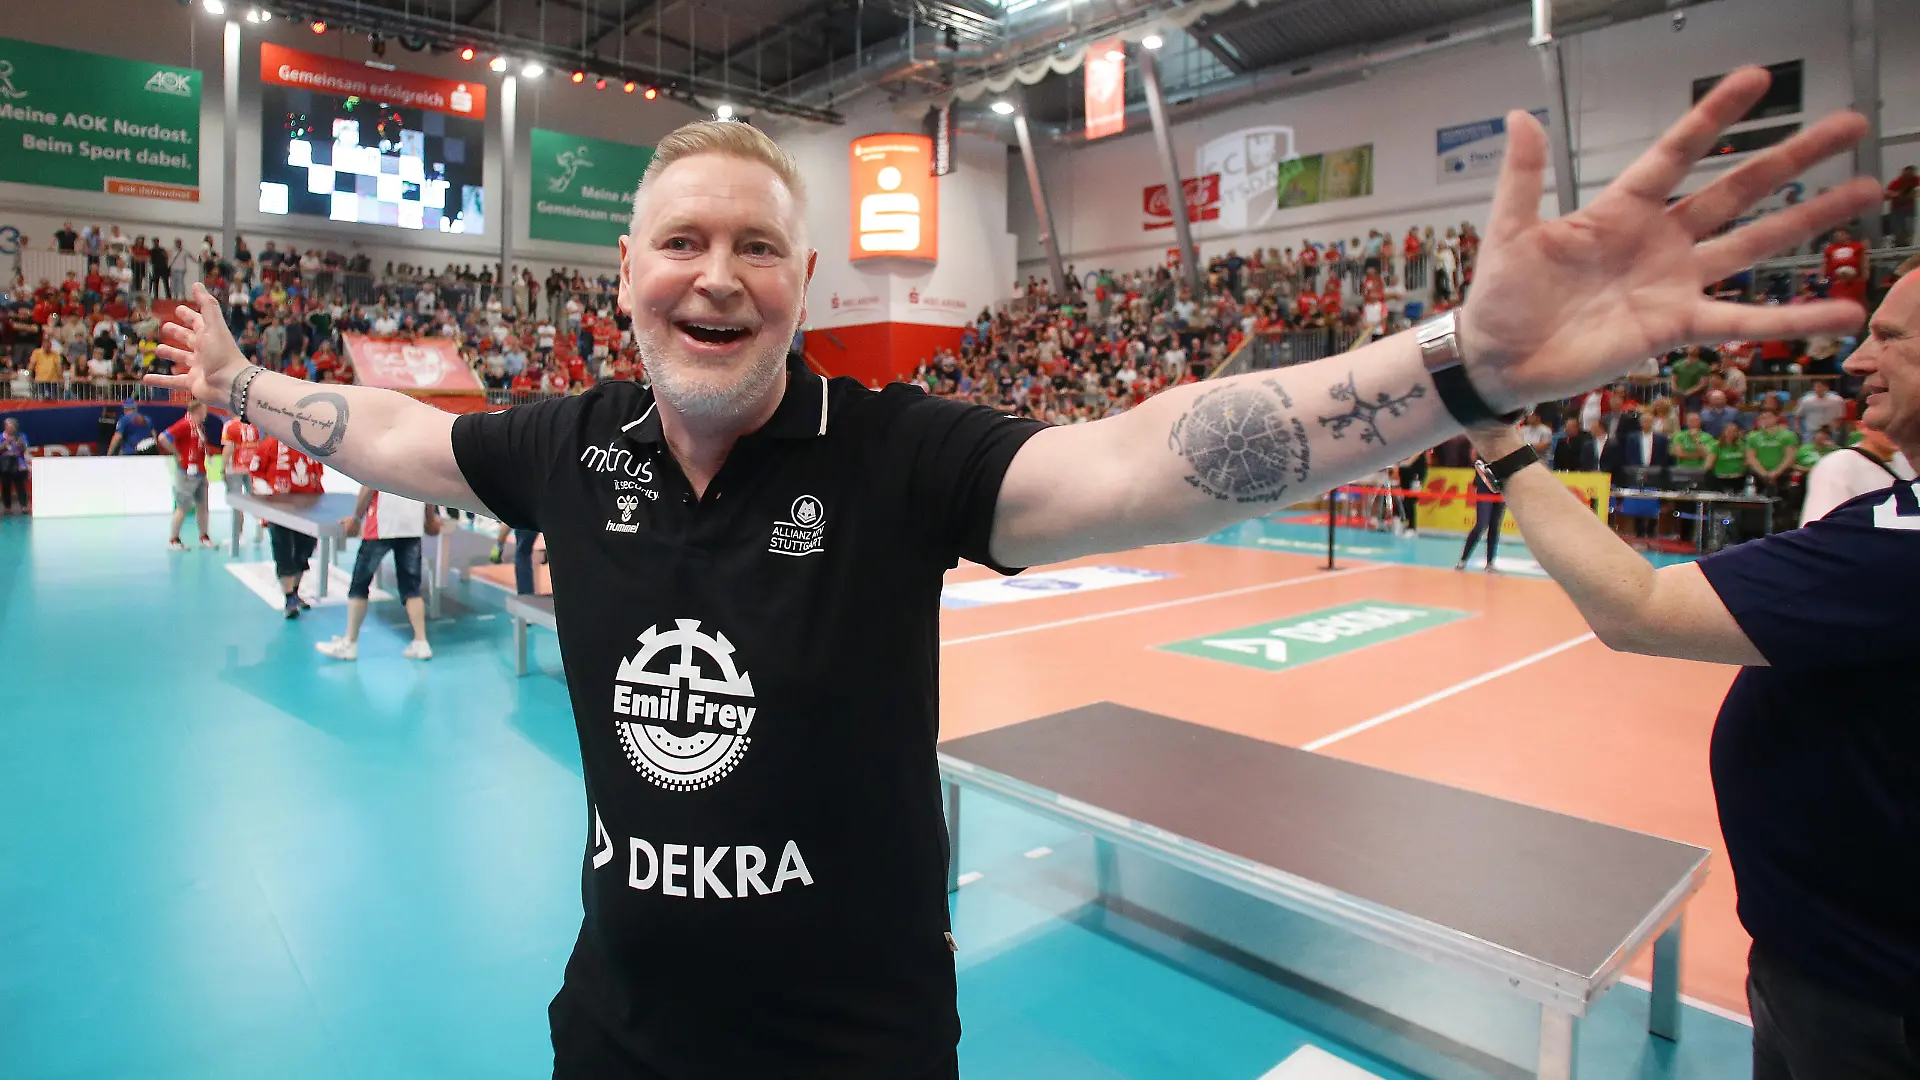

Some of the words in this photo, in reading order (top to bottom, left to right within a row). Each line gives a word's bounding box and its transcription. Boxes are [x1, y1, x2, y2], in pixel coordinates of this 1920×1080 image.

[147, 70, 192, 94] AOK
[278, 64, 367, 93] Gemeinsam
[369, 84, 444, 108] erfolgreich
[63, 112, 109, 133] AOK
[113, 118, 192, 145] Nordost.
[22, 133, 73, 155] Beim
[79, 141, 132, 162] Sport
[136, 148, 192, 171] dabei.
[605, 519, 640, 534] hummel
[771, 526, 812, 541] ALLIANZ
[769, 536, 824, 552] STUTTGART
[613, 684, 680, 721] Emil
[686, 694, 757, 735] Frey
[628, 836, 815, 899] DEKRA
